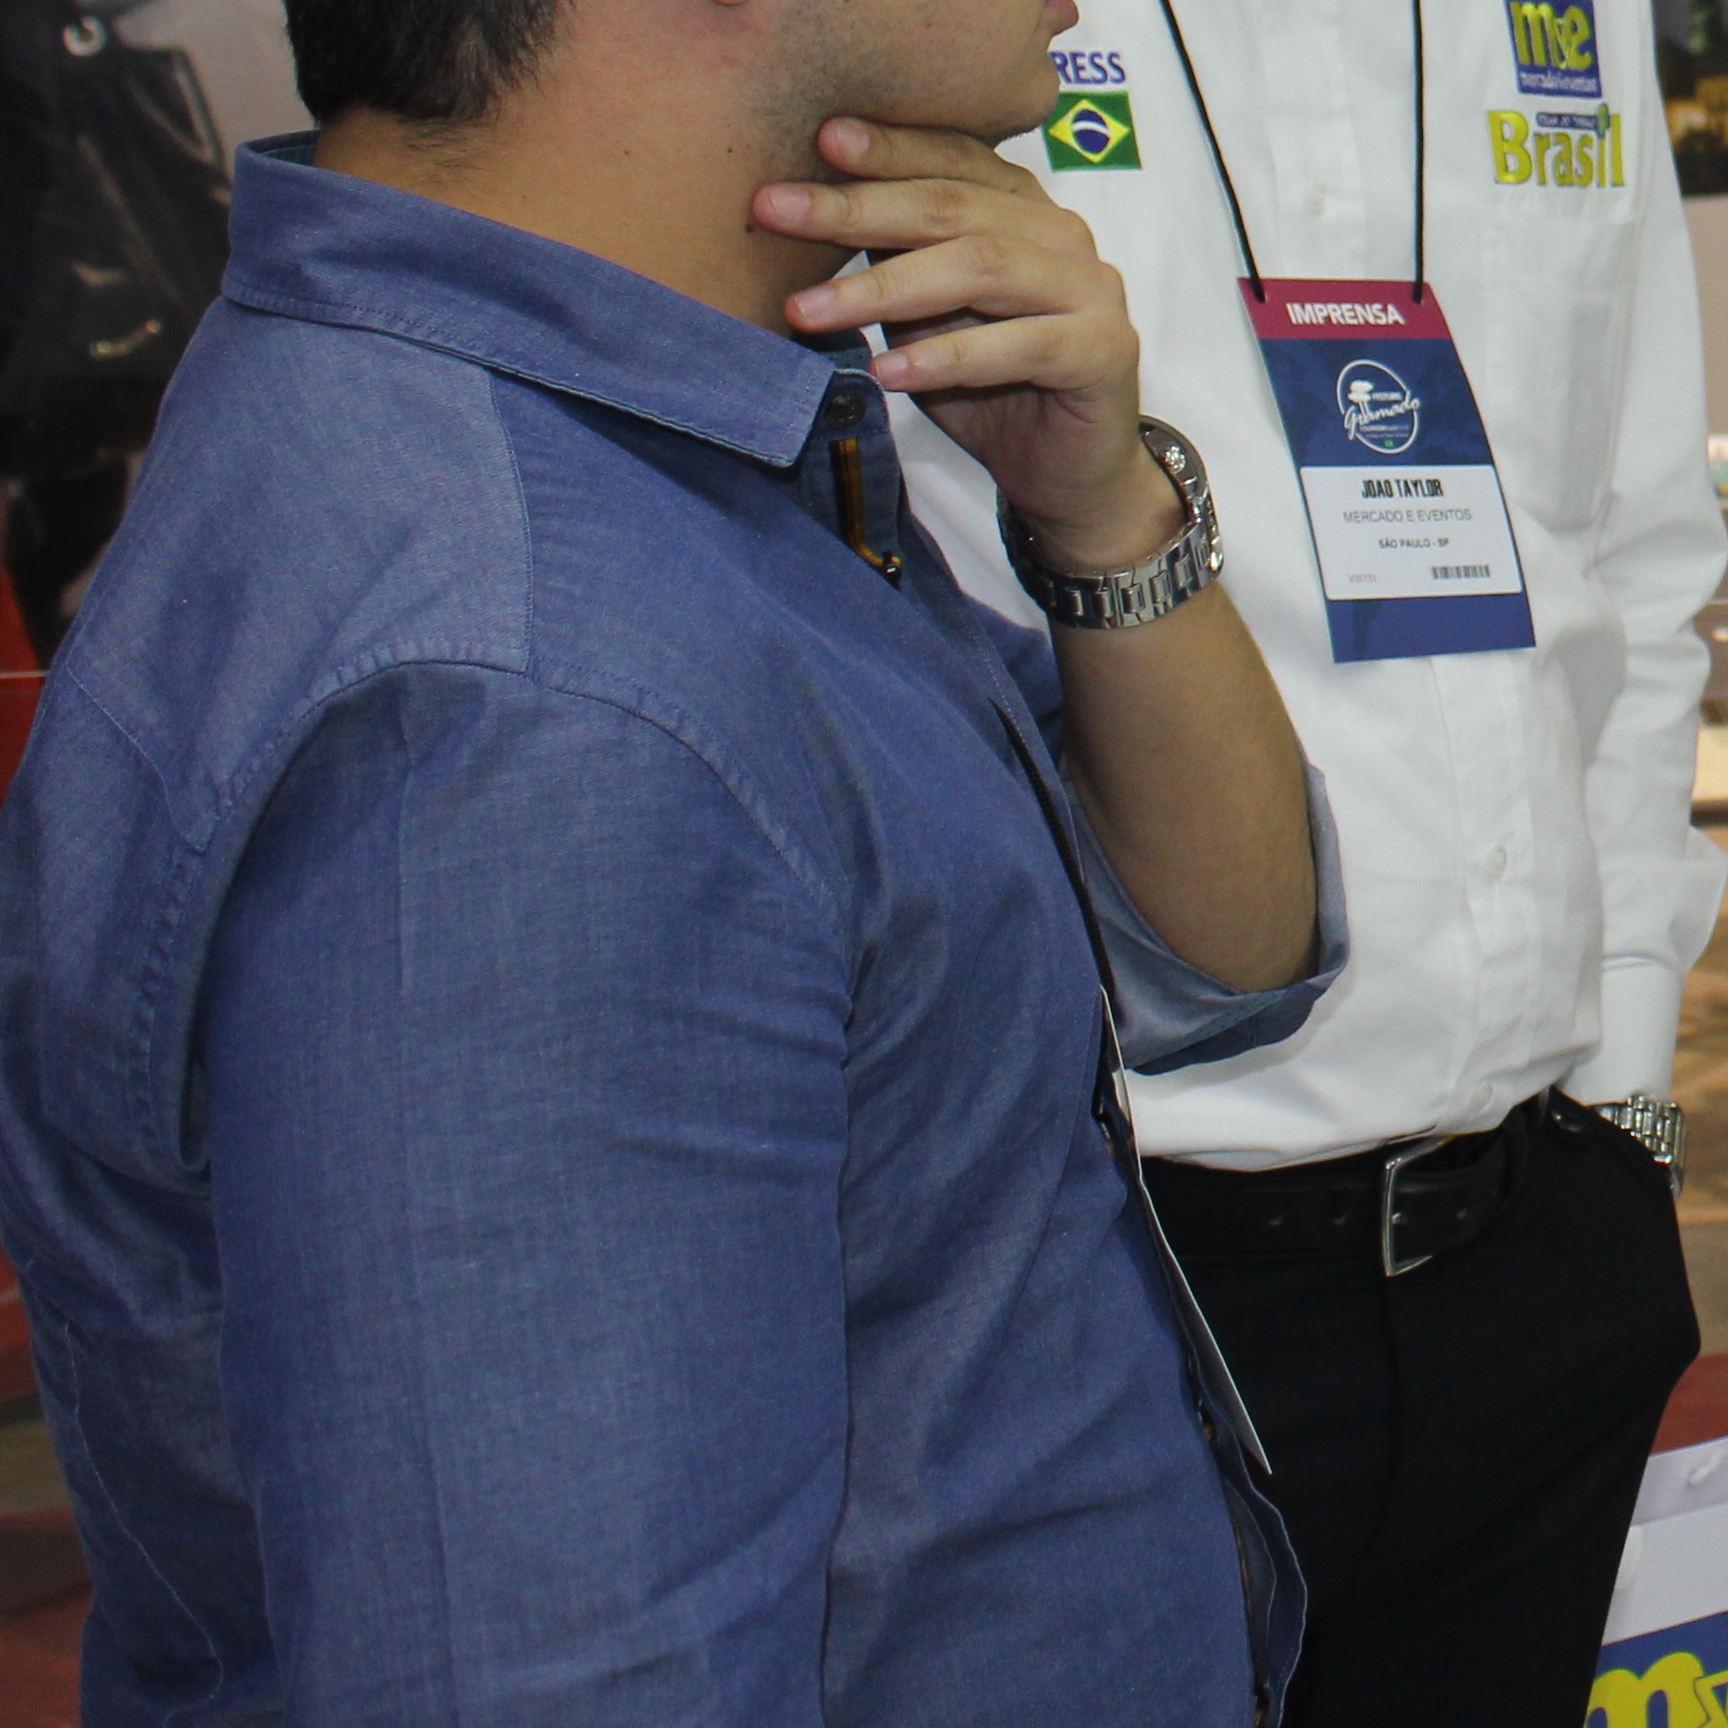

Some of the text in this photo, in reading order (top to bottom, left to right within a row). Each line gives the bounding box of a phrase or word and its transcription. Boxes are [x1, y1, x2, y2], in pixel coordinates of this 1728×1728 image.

[1049, 51, 1126, 84] RESS
[1488, 103, 1625, 189] Brasil
[1285, 301, 1406, 326] IMPRENSA
[1394, 478, 1444, 498] TAYLOR
[1343, 508, 1473, 523] MERCADO E EVENTOS
